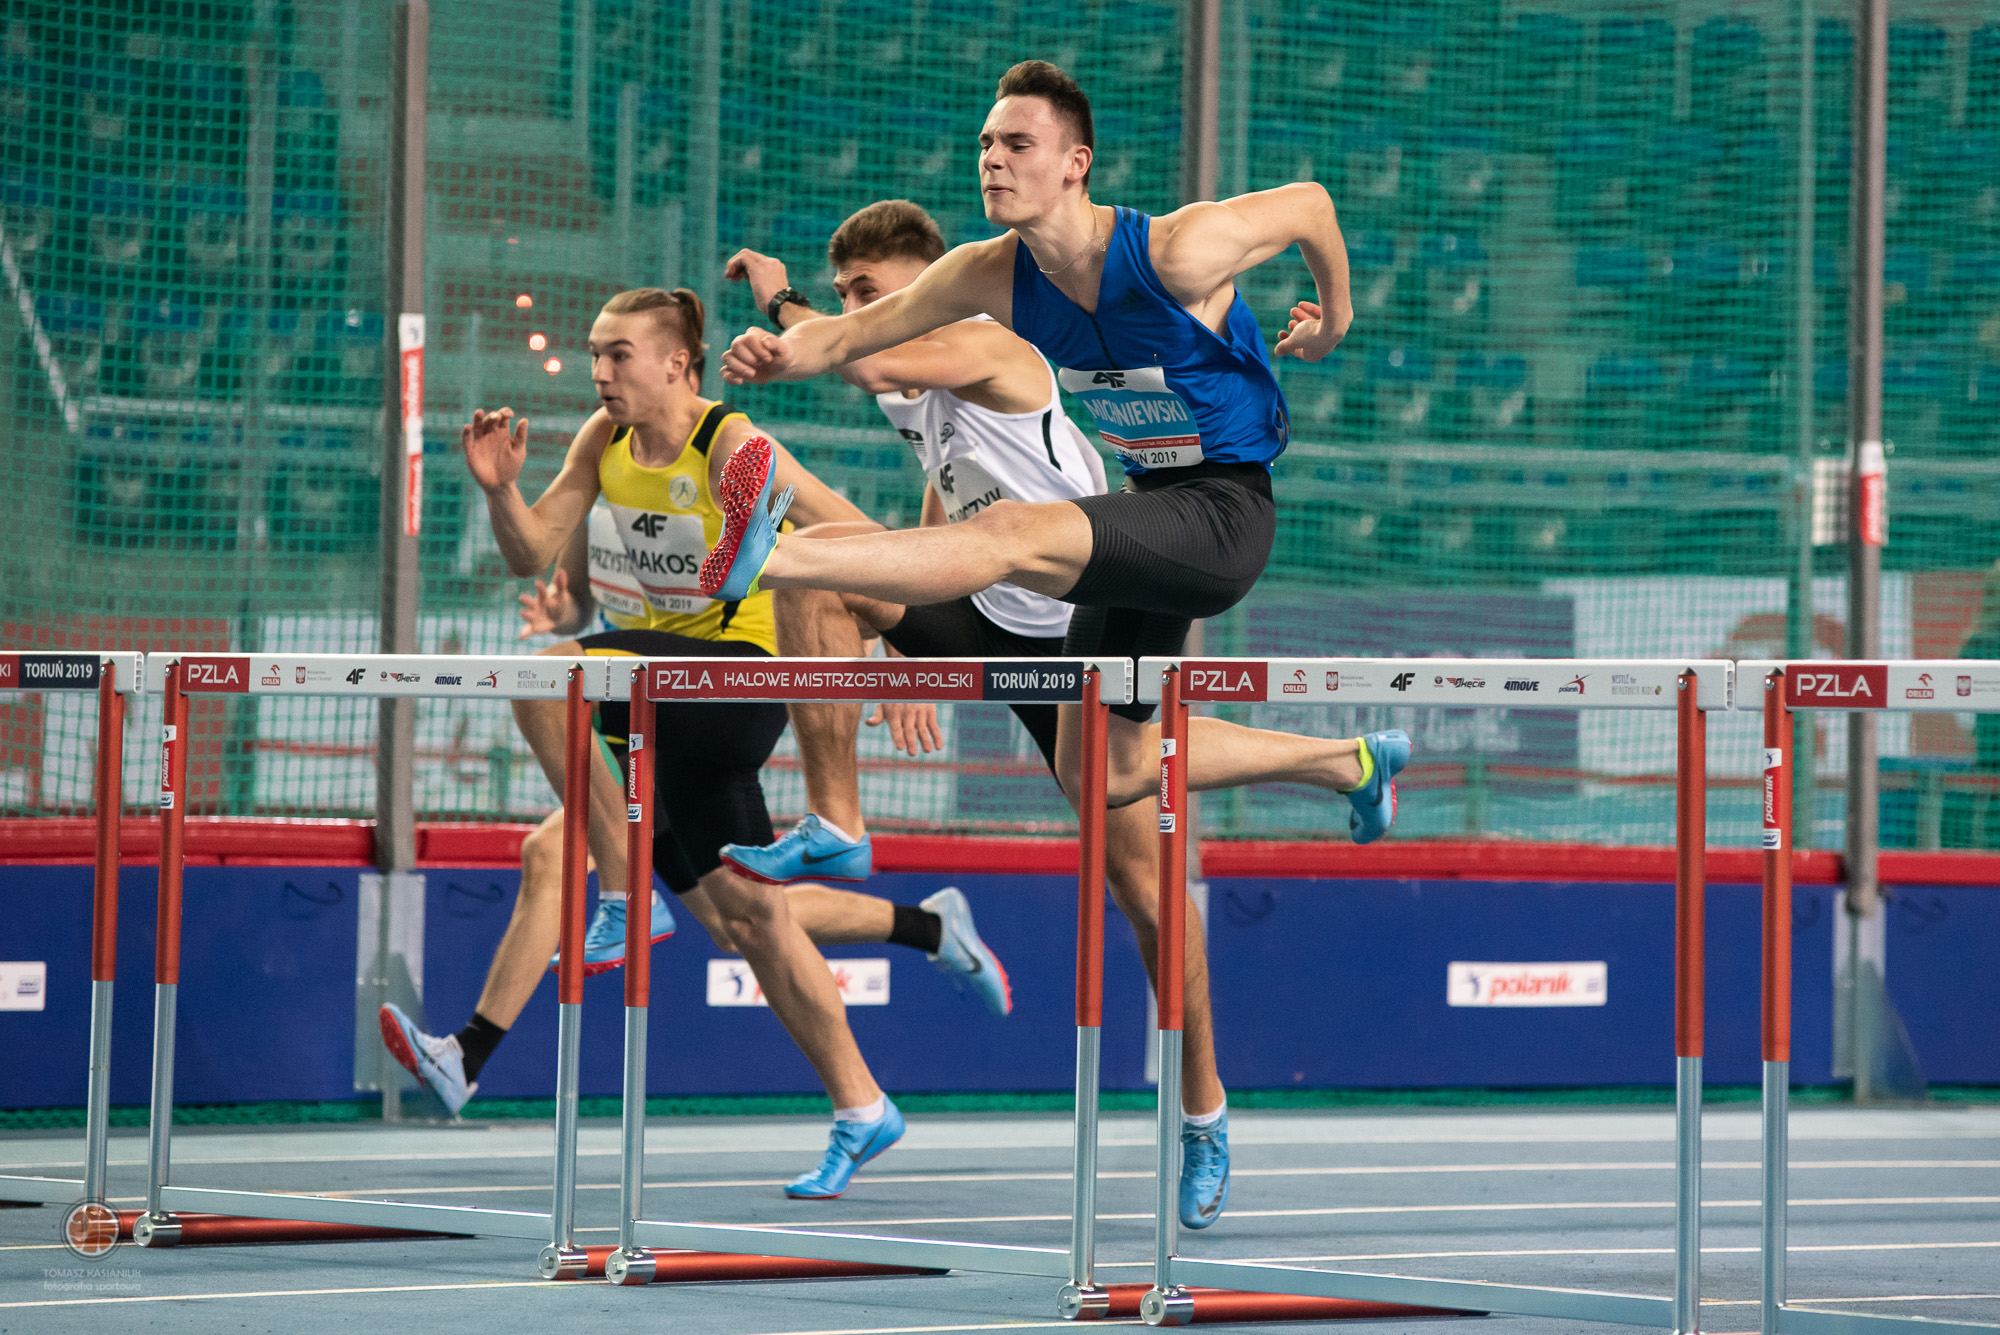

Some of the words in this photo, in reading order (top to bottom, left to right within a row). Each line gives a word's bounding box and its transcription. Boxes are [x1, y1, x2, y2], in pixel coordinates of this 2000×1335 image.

[1092, 371, 1127, 388] 4F
[1150, 451, 1177, 464] 2019
[631, 512, 668, 538] 4F
[669, 598, 692, 609] 2019
[24, 660, 64, 678] TORUŃ
[65, 664, 93, 678] 2019
[188, 664, 239, 684] PZLA
[346, 668, 366, 684] 4F
[656, 669, 714, 690] PZLA
[724, 672, 790, 687] HALOWE
[793, 672, 911, 688] MISTRZOSTWA
[915, 673, 973, 688] POLSKI
[991, 669, 1039, 689] TORUŃ
[1041, 673, 1076, 689] 2019
[1190, 670, 1255, 691] PZLA
[1284, 684, 1307, 693] ORLEN
[1390, 672, 1415, 691] 4F
[1503, 680, 1540, 691] 4MOVE
[1796, 674, 1872, 697] PZLA
[629, 757, 638, 799] polanik
[1161, 763, 1170, 809] polanik
[1765, 775, 1776, 824] polanik
